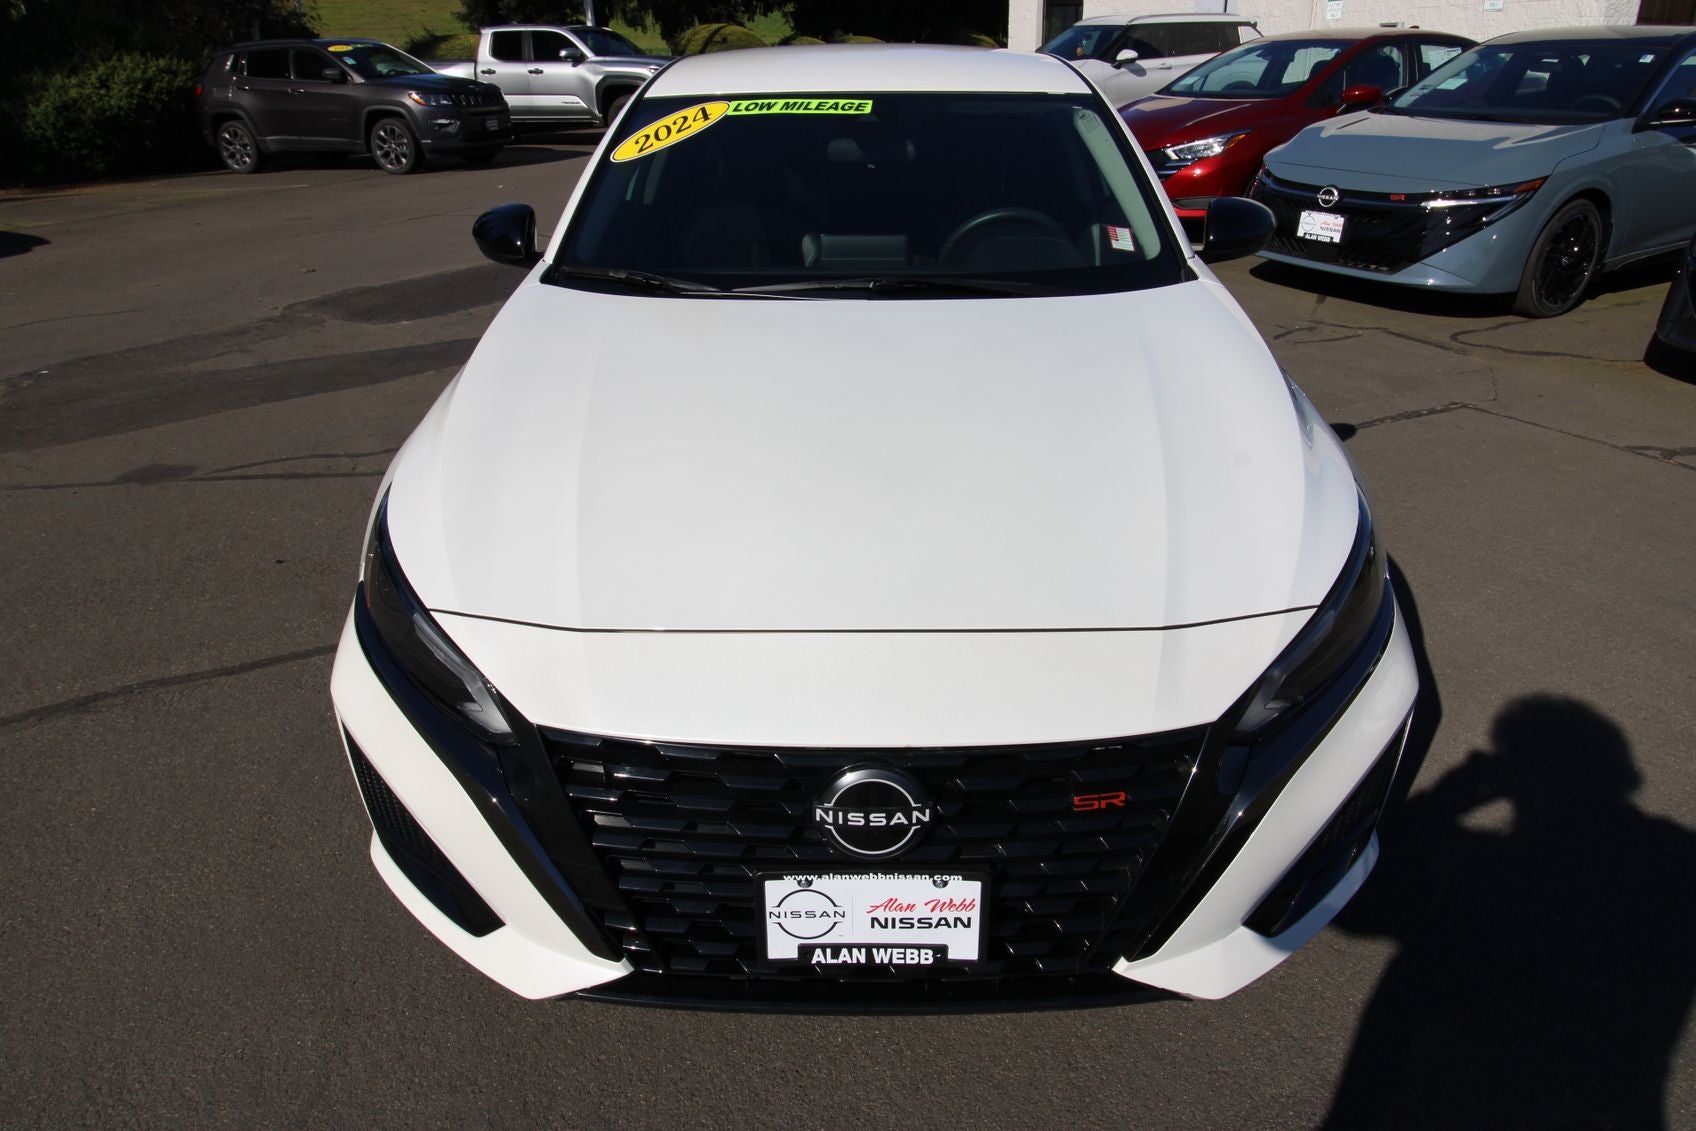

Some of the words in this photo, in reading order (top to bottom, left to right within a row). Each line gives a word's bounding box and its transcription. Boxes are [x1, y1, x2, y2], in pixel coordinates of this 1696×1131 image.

[733, 101, 776, 112] LOW
[780, 101, 868, 112] MILEAGE
[634, 106, 713, 154] 2024
[1072, 791, 1127, 811] SR
[815, 808, 930, 826] NISSAN
[783, 872, 963, 882] www.alanwebbnissan.com
[865, 897, 916, 914] Alan
[923, 897, 976, 913] Webb
[769, 910, 846, 919] NISSAN
[870, 916, 972, 930] NISSAN
[811, 948, 866, 964] ALAN
[872, 948, 934, 964] WEBB
